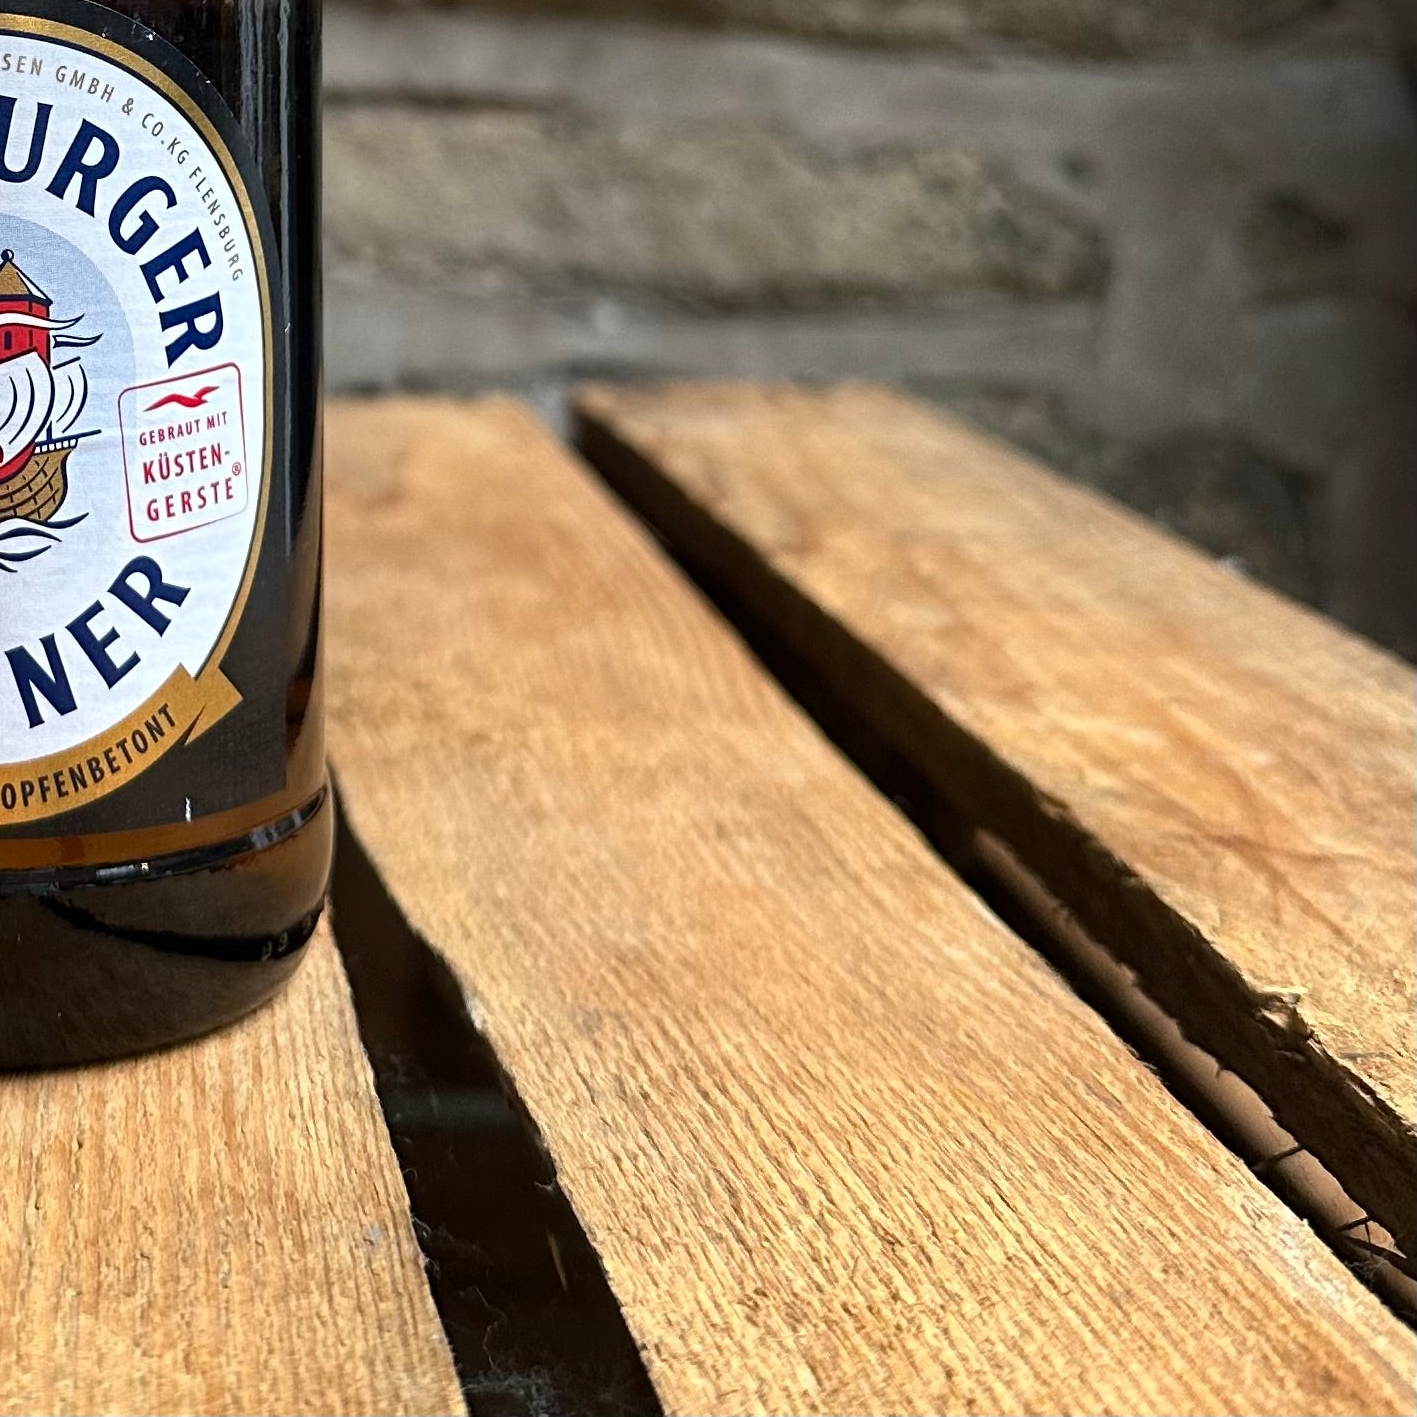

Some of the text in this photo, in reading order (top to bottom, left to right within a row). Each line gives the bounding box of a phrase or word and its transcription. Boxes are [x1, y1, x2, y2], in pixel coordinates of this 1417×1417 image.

[55, 64, 116, 103] GMBH
[121, 97, 135, 116] &
[188, 165, 244, 282] FLENSBURG
[138, 410, 228, 446] GEBRAUT MIT
[142, 442, 231, 485] KÜSTEN-
